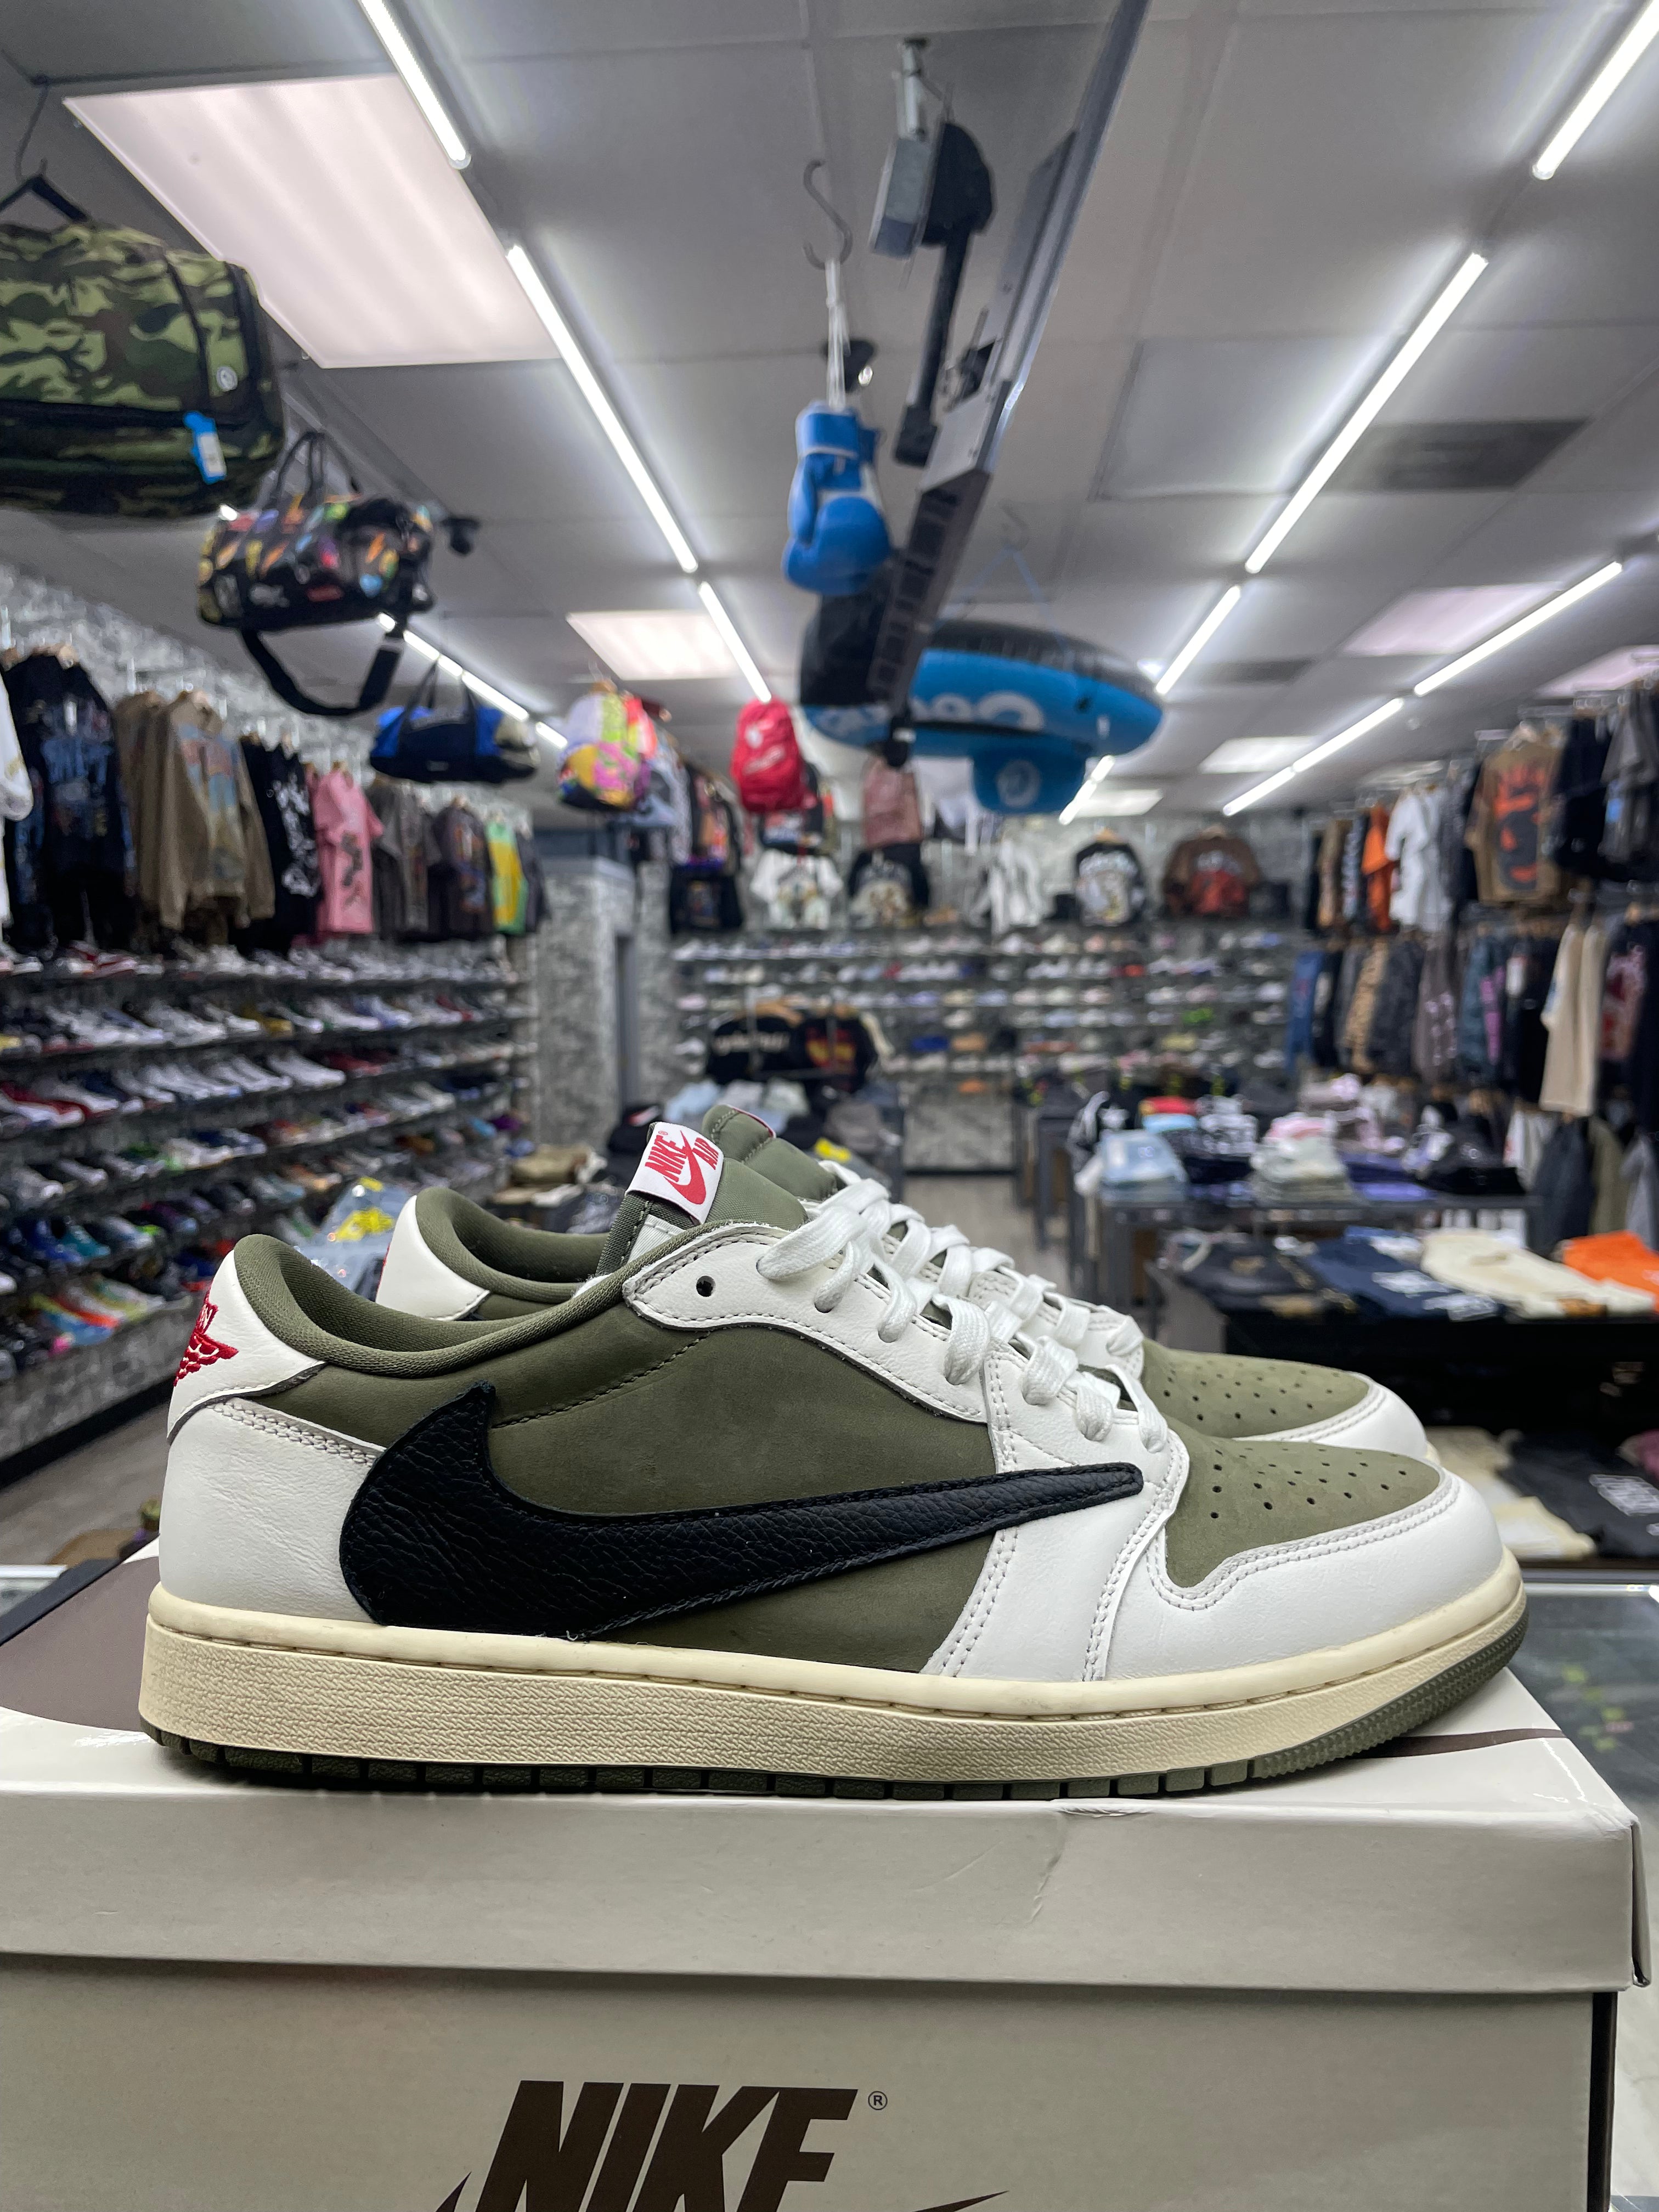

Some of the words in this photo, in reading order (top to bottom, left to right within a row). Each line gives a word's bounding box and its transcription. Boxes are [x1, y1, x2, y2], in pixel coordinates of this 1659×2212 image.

[645, 1135, 687, 1182] NIKE
[692, 1137, 719, 1170] AIR
[475, 2080, 859, 2212] NIKE
